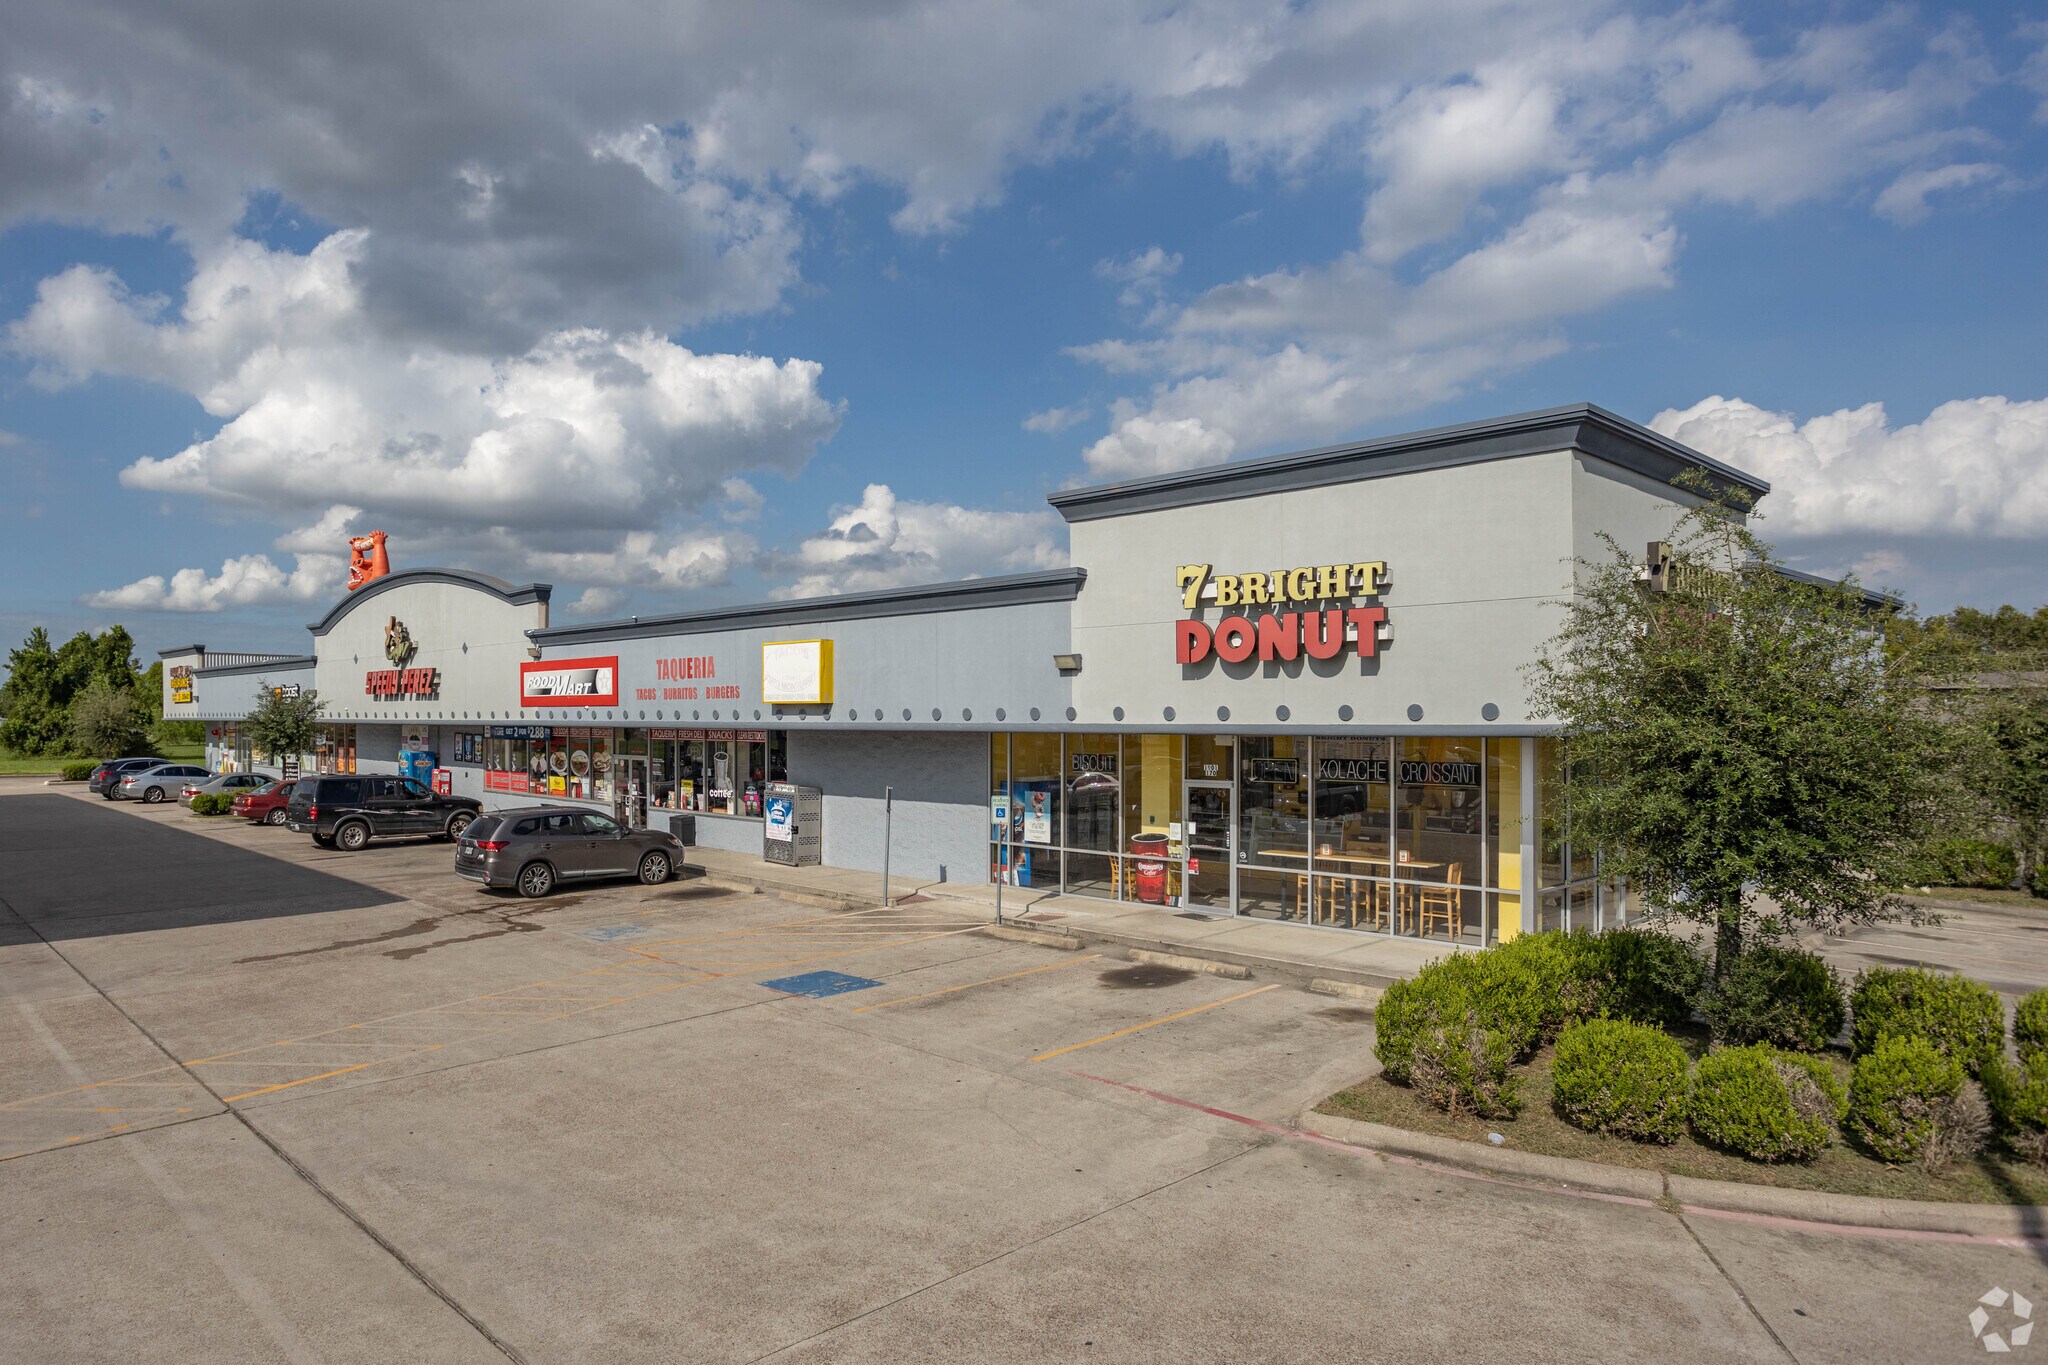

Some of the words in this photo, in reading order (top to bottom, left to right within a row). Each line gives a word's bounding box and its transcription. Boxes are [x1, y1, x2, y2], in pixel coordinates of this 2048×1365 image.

[1176, 564, 1211, 609] 7
[1214, 561, 1387, 606] BRIGHT
[1176, 607, 1387, 664] DONUT
[656, 656, 716, 682] TAQUERIA
[365, 670, 399, 695] SPEEDY
[401, 668, 433, 694] PEREZ
[636, 688, 657, 701] TACOS
[663, 687, 698, 701] BURRITOS
[705, 686, 741, 699] BURGERS
[514, 727, 519, 737] 2
[519, 728, 527, 736] FOR
[679, 730, 693, 738] FRESH
[694, 730, 703, 739] DEL
[708, 730, 733, 739] SNACKS
[1072, 754, 1115, 771] BISCUIT
[1319, 759, 1387, 781] KOLACHE
[1400, 762, 1478, 784] CROISSANT
[709, 788, 733, 798] coffee
